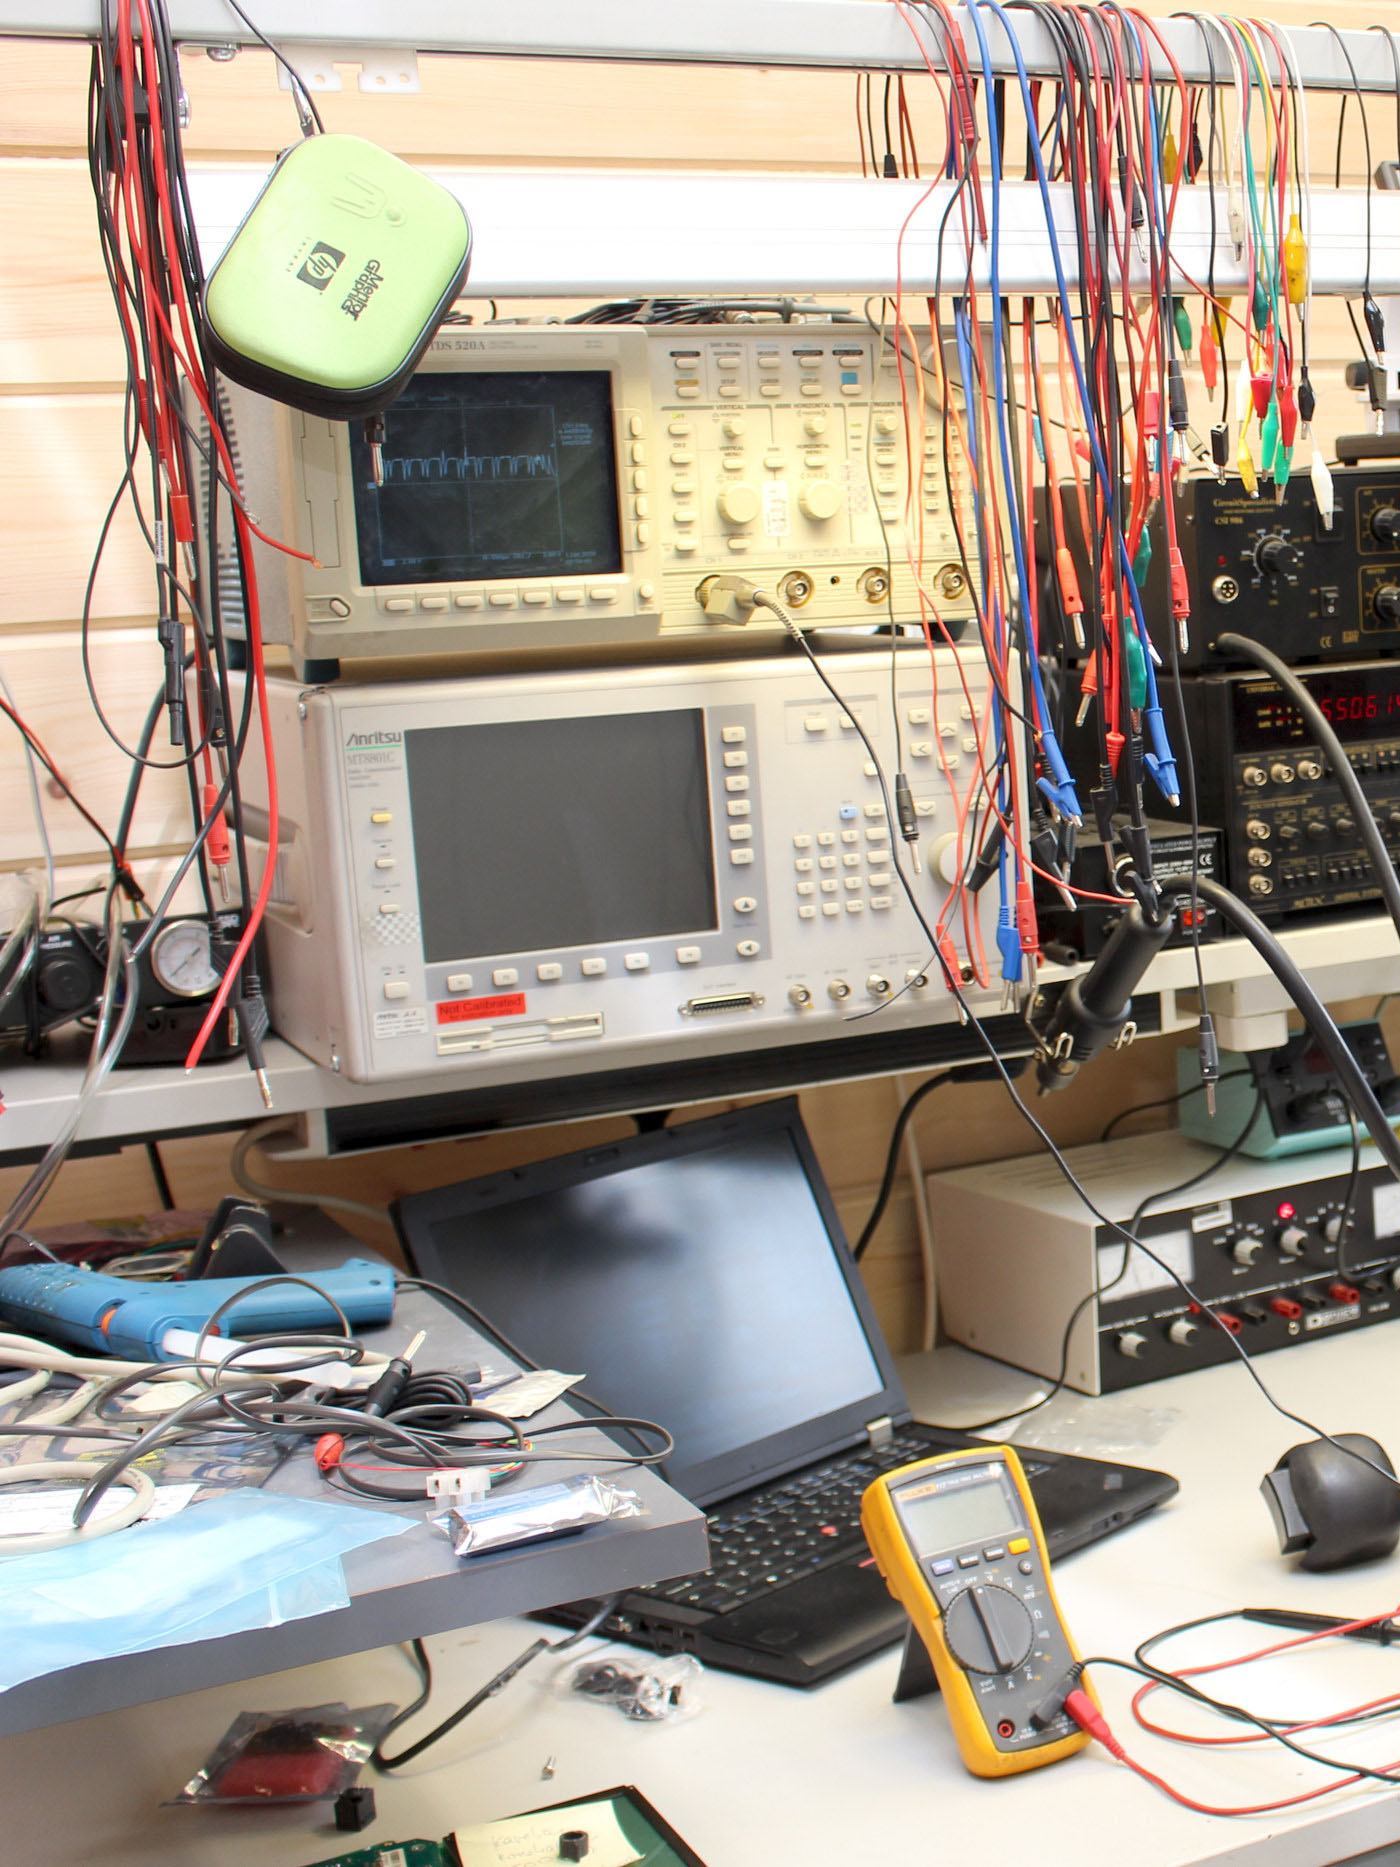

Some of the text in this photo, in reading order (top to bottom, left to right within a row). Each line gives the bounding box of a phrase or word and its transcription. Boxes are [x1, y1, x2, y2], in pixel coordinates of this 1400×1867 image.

[341, 259, 381, 314] Graphics
[349, 274, 384, 321] Mentor
[455, 340, 486, 351] 520A
[345, 732, 402, 747] Anritsu
[439, 997, 522, 1016] Not Calibrated
[964, 1575, 978, 1585] OFF
